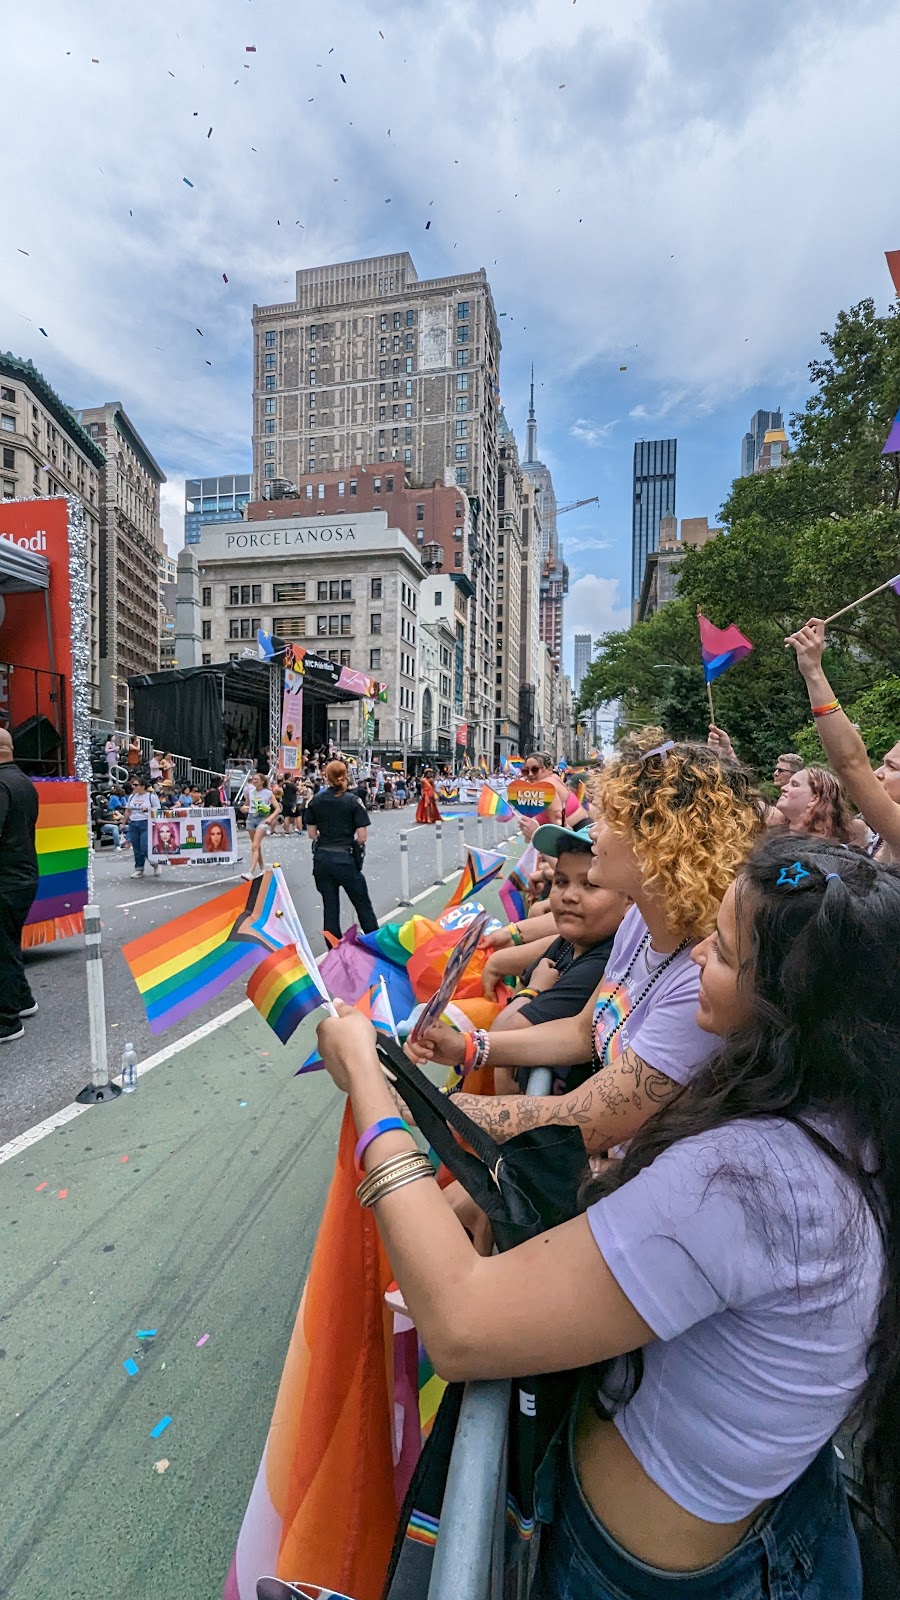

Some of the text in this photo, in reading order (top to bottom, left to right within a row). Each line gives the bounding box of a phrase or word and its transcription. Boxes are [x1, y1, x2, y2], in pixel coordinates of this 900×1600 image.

[227, 527, 356, 549] PORCELANOSA
[517, 790, 545, 799] LOVE
[517, 798, 545, 807] WINS
